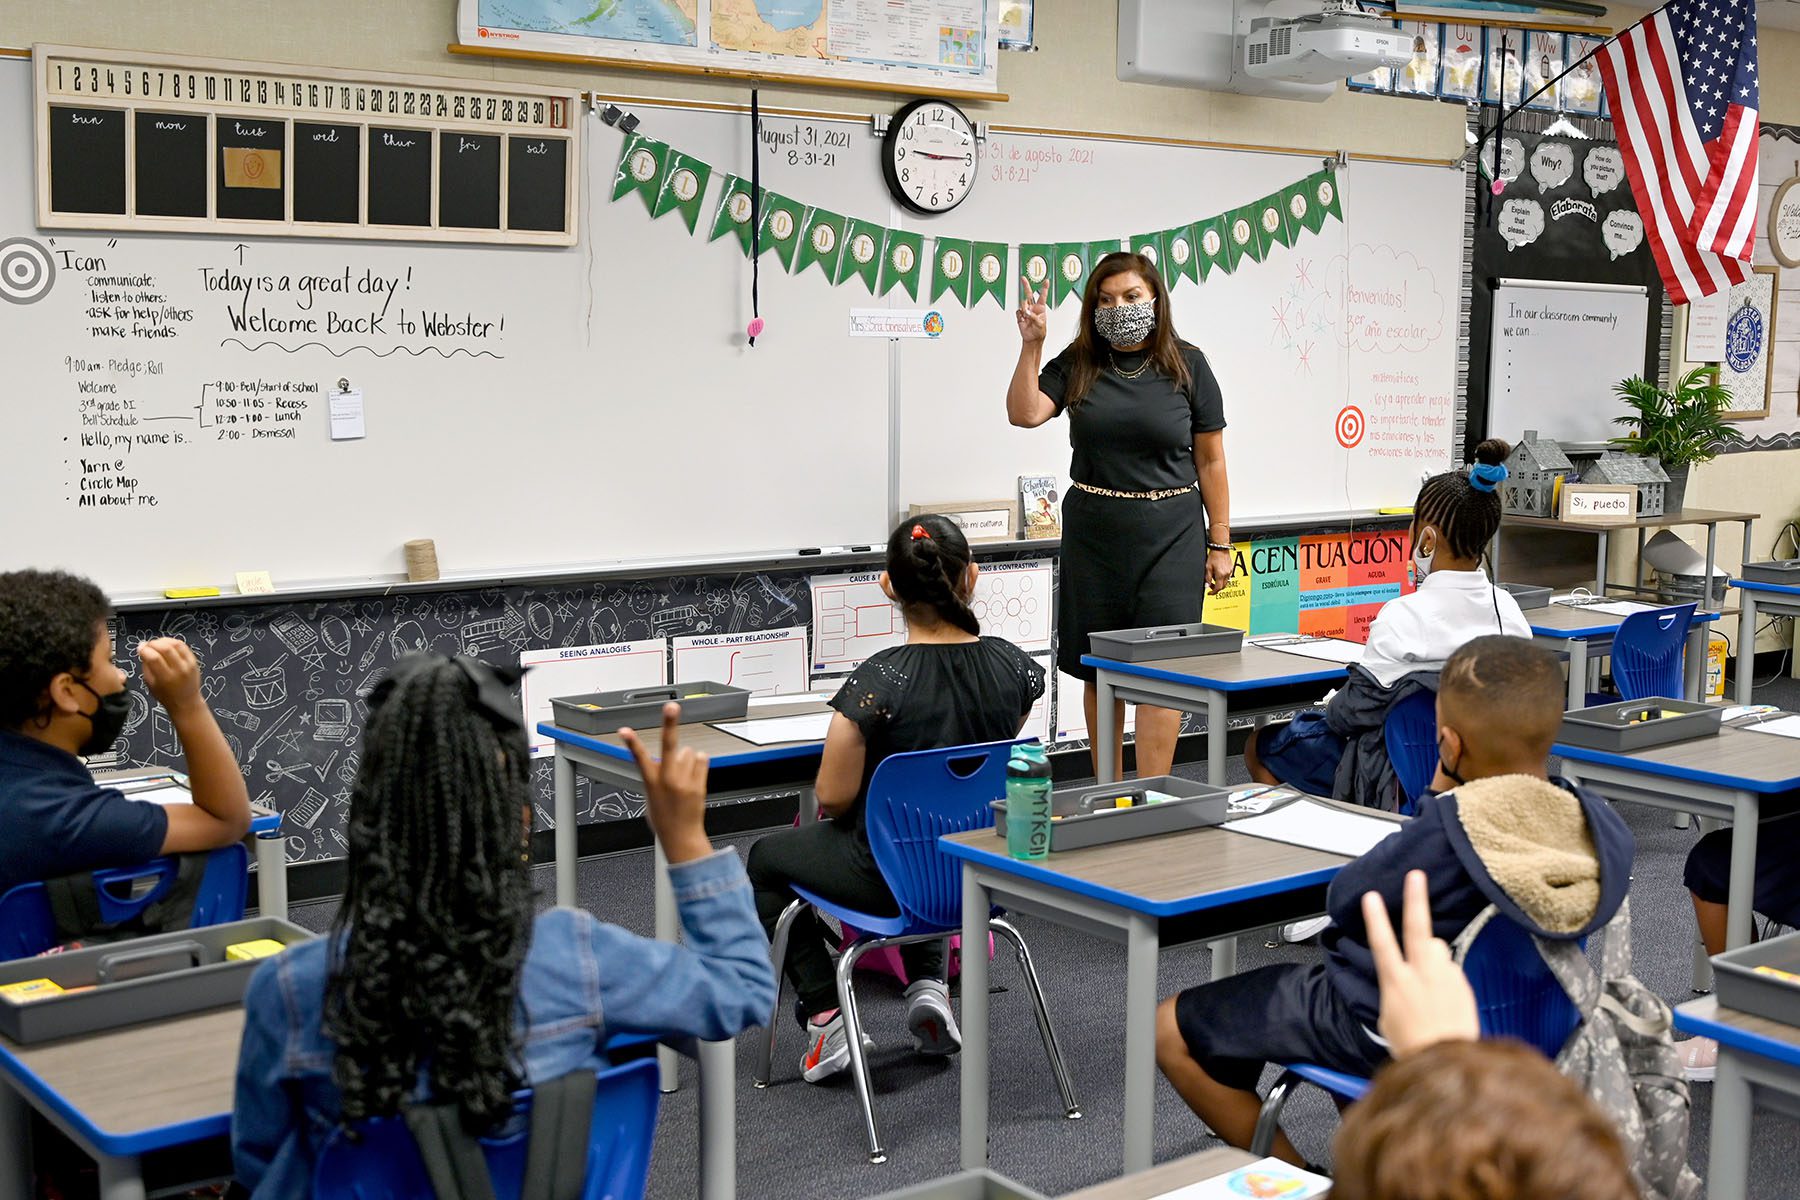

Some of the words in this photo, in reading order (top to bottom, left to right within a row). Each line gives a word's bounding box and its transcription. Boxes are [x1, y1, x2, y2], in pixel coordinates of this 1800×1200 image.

[1456, 24, 1473, 42] Uu
[1536, 34, 1557, 54] Ww
[57, 65, 62, 90] 1
[74, 67, 81, 91] 2
[91, 68, 98, 92] 3
[107, 69, 114, 93] 4
[124, 70, 132, 95] 5
[142, 71, 149, 96] 6
[158, 73, 164, 96] 7
[173, 74, 180, 98] 8
[189, 75, 195, 99] 9
[205, 76, 215, 100] 10
[224, 77, 232, 101] 11
[240, 79, 251, 103] 12
[257, 80, 267, 104] 13
[274, 81, 285, 105] 14
[292, 83, 302, 106] 15
[308, 84, 318, 107] 16
[324, 85, 334, 109] 17
[340, 87, 350, 110] 18
[356, 88, 366, 112] 19
[371, 89, 382, 113] 20
[388, 90, 399, 114] 21
[404, 91, 415, 115] 22
[420, 93, 431, 116] 23
[437, 94, 448, 117] 24
[454, 95, 465, 118] 25
[470, 96, 482, 119] 26
[486, 98, 497, 121] 27
[501, 99, 513, 122] 28
[517, 100, 528, 123] 29
[533, 102, 544, 124] 30
[916, 112, 926, 126] 11
[932, 109, 944, 121] 12
[951, 117, 956, 130] 1
[72, 113, 104, 125] sun
[156, 120, 186, 131] mon
[235, 121, 267, 137] tues
[312, 129, 339, 144] wed
[383, 132, 415, 147] thur
[459, 137, 481, 153] fri
[526, 141, 548, 155] sat
[757, 118, 800, 154] August
[902, 126, 914, 140] 10
[961, 131, 969, 146] 2
[787, 150, 835, 167] 8-31-21
[897, 147, 906, 161] 9
[965, 153, 972, 167] 3
[991, 142, 1003, 160] 31
[1009, 144, 1021, 160] de
[1025, 145, 1062, 172] agosto
[1068, 148, 1094, 164] 2021
[1541, 156, 1562, 170] Why?
[1599, 166, 1615, 174] picture
[901, 168, 909, 182] 8
[959, 173, 966, 186] 4
[915, 186, 923, 200] 7
[931, 192, 938, 206] 6
[946, 188, 954, 202] 5
[1511, 206, 1531, 216] Explain
[1551, 200, 1597, 220] Elaborate
[1610, 220, 1634, 231] Convince
[91, 290, 121, 303] listen
[120, 291, 133, 303] to
[198, 268, 253, 318] Today
[257, 275, 273, 292] is
[278, 276, 290, 292] a
[296, 266, 351, 310] great
[89, 307, 112, 318] ask
[115, 306, 130, 320] for
[227, 304, 318, 333] Welcome
[327, 311, 387, 335] Back
[397, 308, 416, 335] to
[1508, 302, 1522, 319] In
[1524, 310, 1537, 320] our
[1540, 305, 1580, 322] classroom
[1582, 312, 1618, 331] community
[92, 326, 126, 338] make
[1365, 320, 1382, 337] año
[1387, 323, 1427, 339] escolar
[1503, 326, 1514, 337] we
[148, 360, 164, 375] Roll
[78, 381, 117, 394] Welcome
[283, 381, 290, 393] of
[97, 401, 120, 418] grade
[275, 398, 308, 409] Recess
[82, 414, 98, 426] Bell
[99, 414, 139, 426] Schedule
[275, 411, 302, 422] Lunch
[252, 427, 295, 439] Dismissal
[81, 432, 113, 450] Hello,
[114, 436, 132, 453] my
[136, 433, 170, 444] name
[80, 459, 110, 474] Yarn
[114, 459, 126, 471] @
[80, 477, 114, 491] Circle
[116, 476, 139, 494] Map
[1023, 479, 1055, 493] Charlotte's
[79, 494, 96, 508] All
[100, 493, 134, 506] about
[138, 495, 158, 506] me
[1231, 535, 1403, 578] ACENTUACIÓN
[998, 562, 1039, 571] CONTRASTING
[691, 637, 719, 646] WHOLE
[726, 635, 744, 643] PART
[745, 631, 790, 643] RELATIONSHIP
[559, 649, 587, 659] SEEING
[590, 645, 631, 655] ANALOGIES
